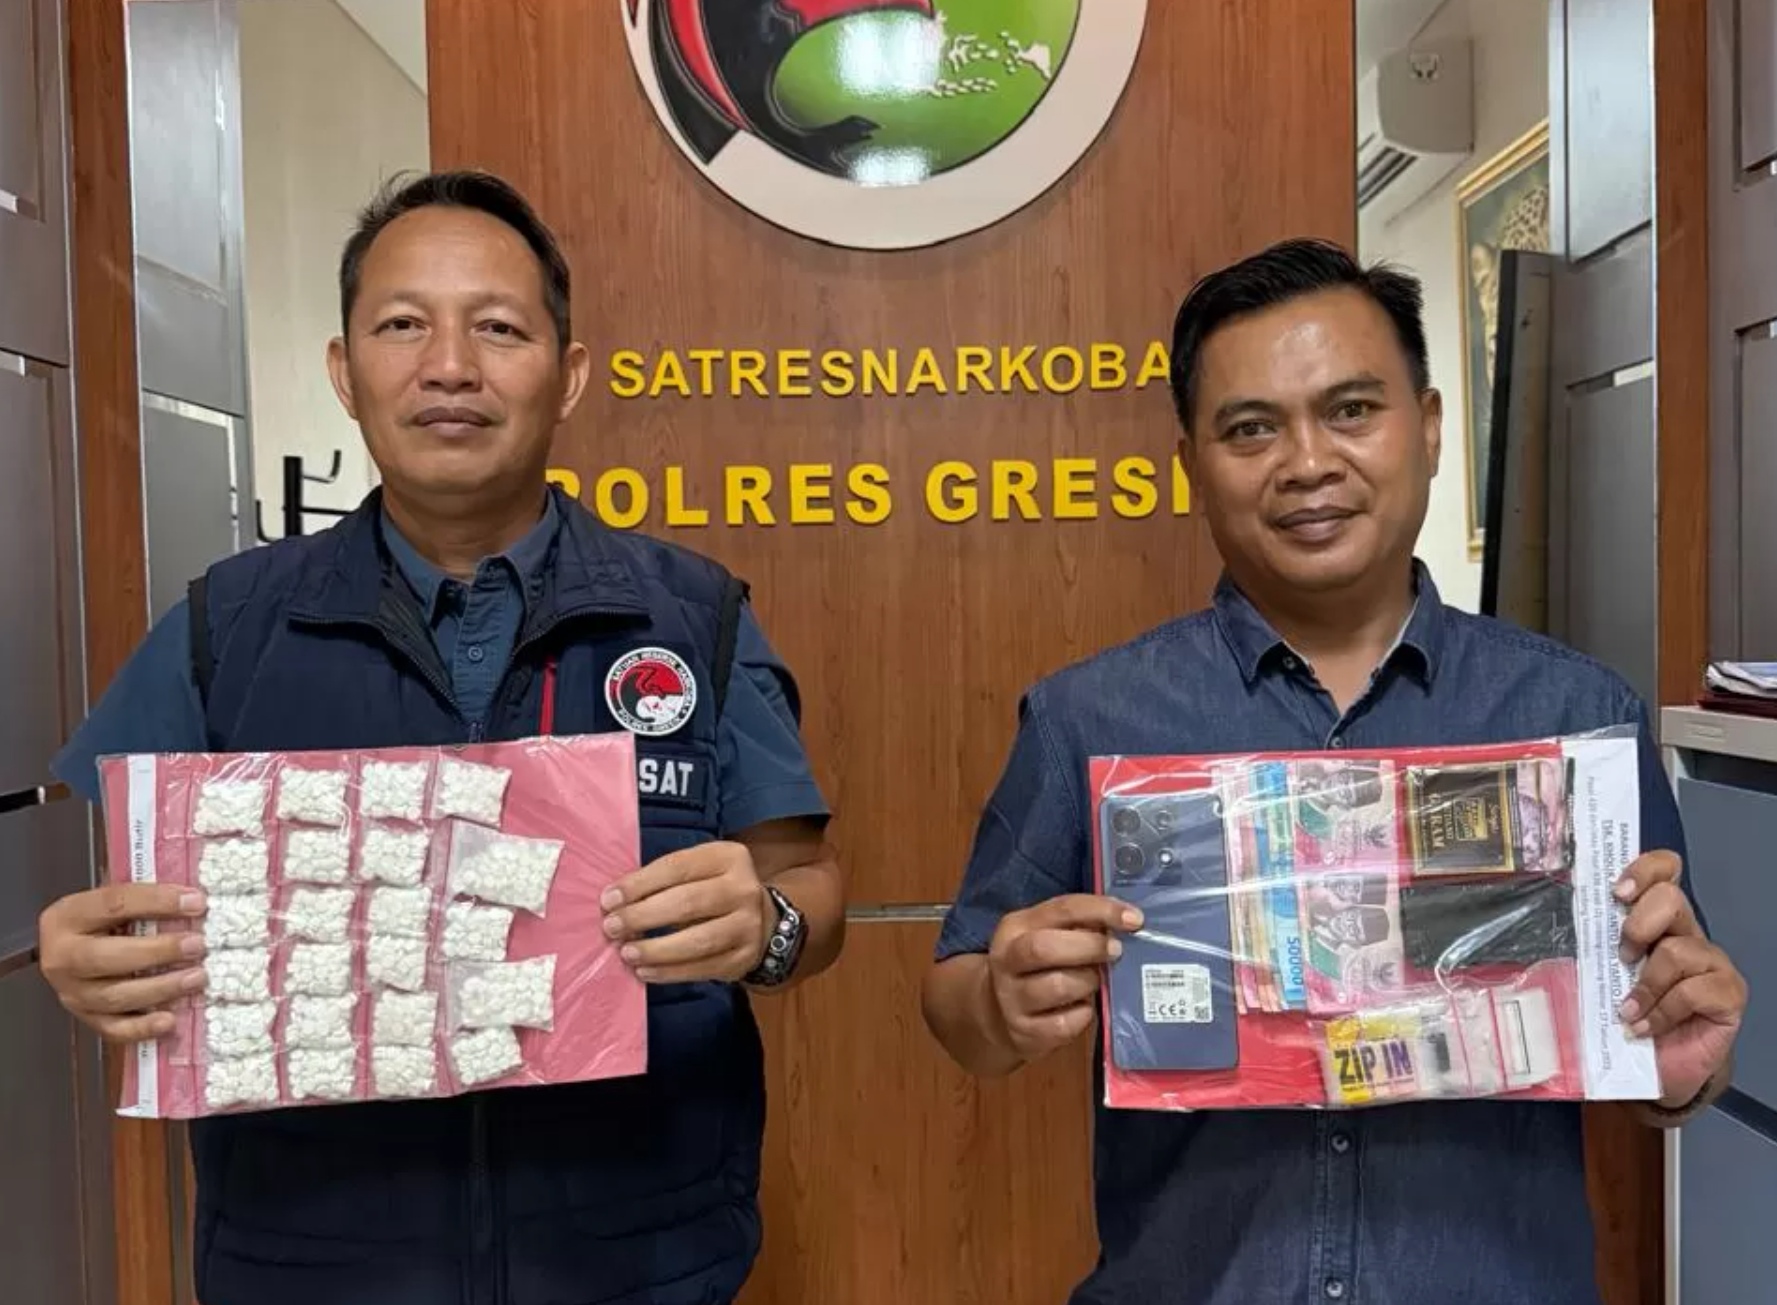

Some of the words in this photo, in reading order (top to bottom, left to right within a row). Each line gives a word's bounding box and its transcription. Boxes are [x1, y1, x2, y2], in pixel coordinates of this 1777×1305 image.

[609, 341, 1171, 397] SATRESNARKOBA
[639, 758, 694, 797] SAT
[1428, 792, 1446, 848] GRAM
[1443, 804, 1455, 840] UDANG
[1619, 822, 1629, 864] BARANG
[1286, 936, 1304, 985] 50000
[1333, 1044, 1375, 1085] ZIP
[1381, 1040, 1414, 1079] IN
